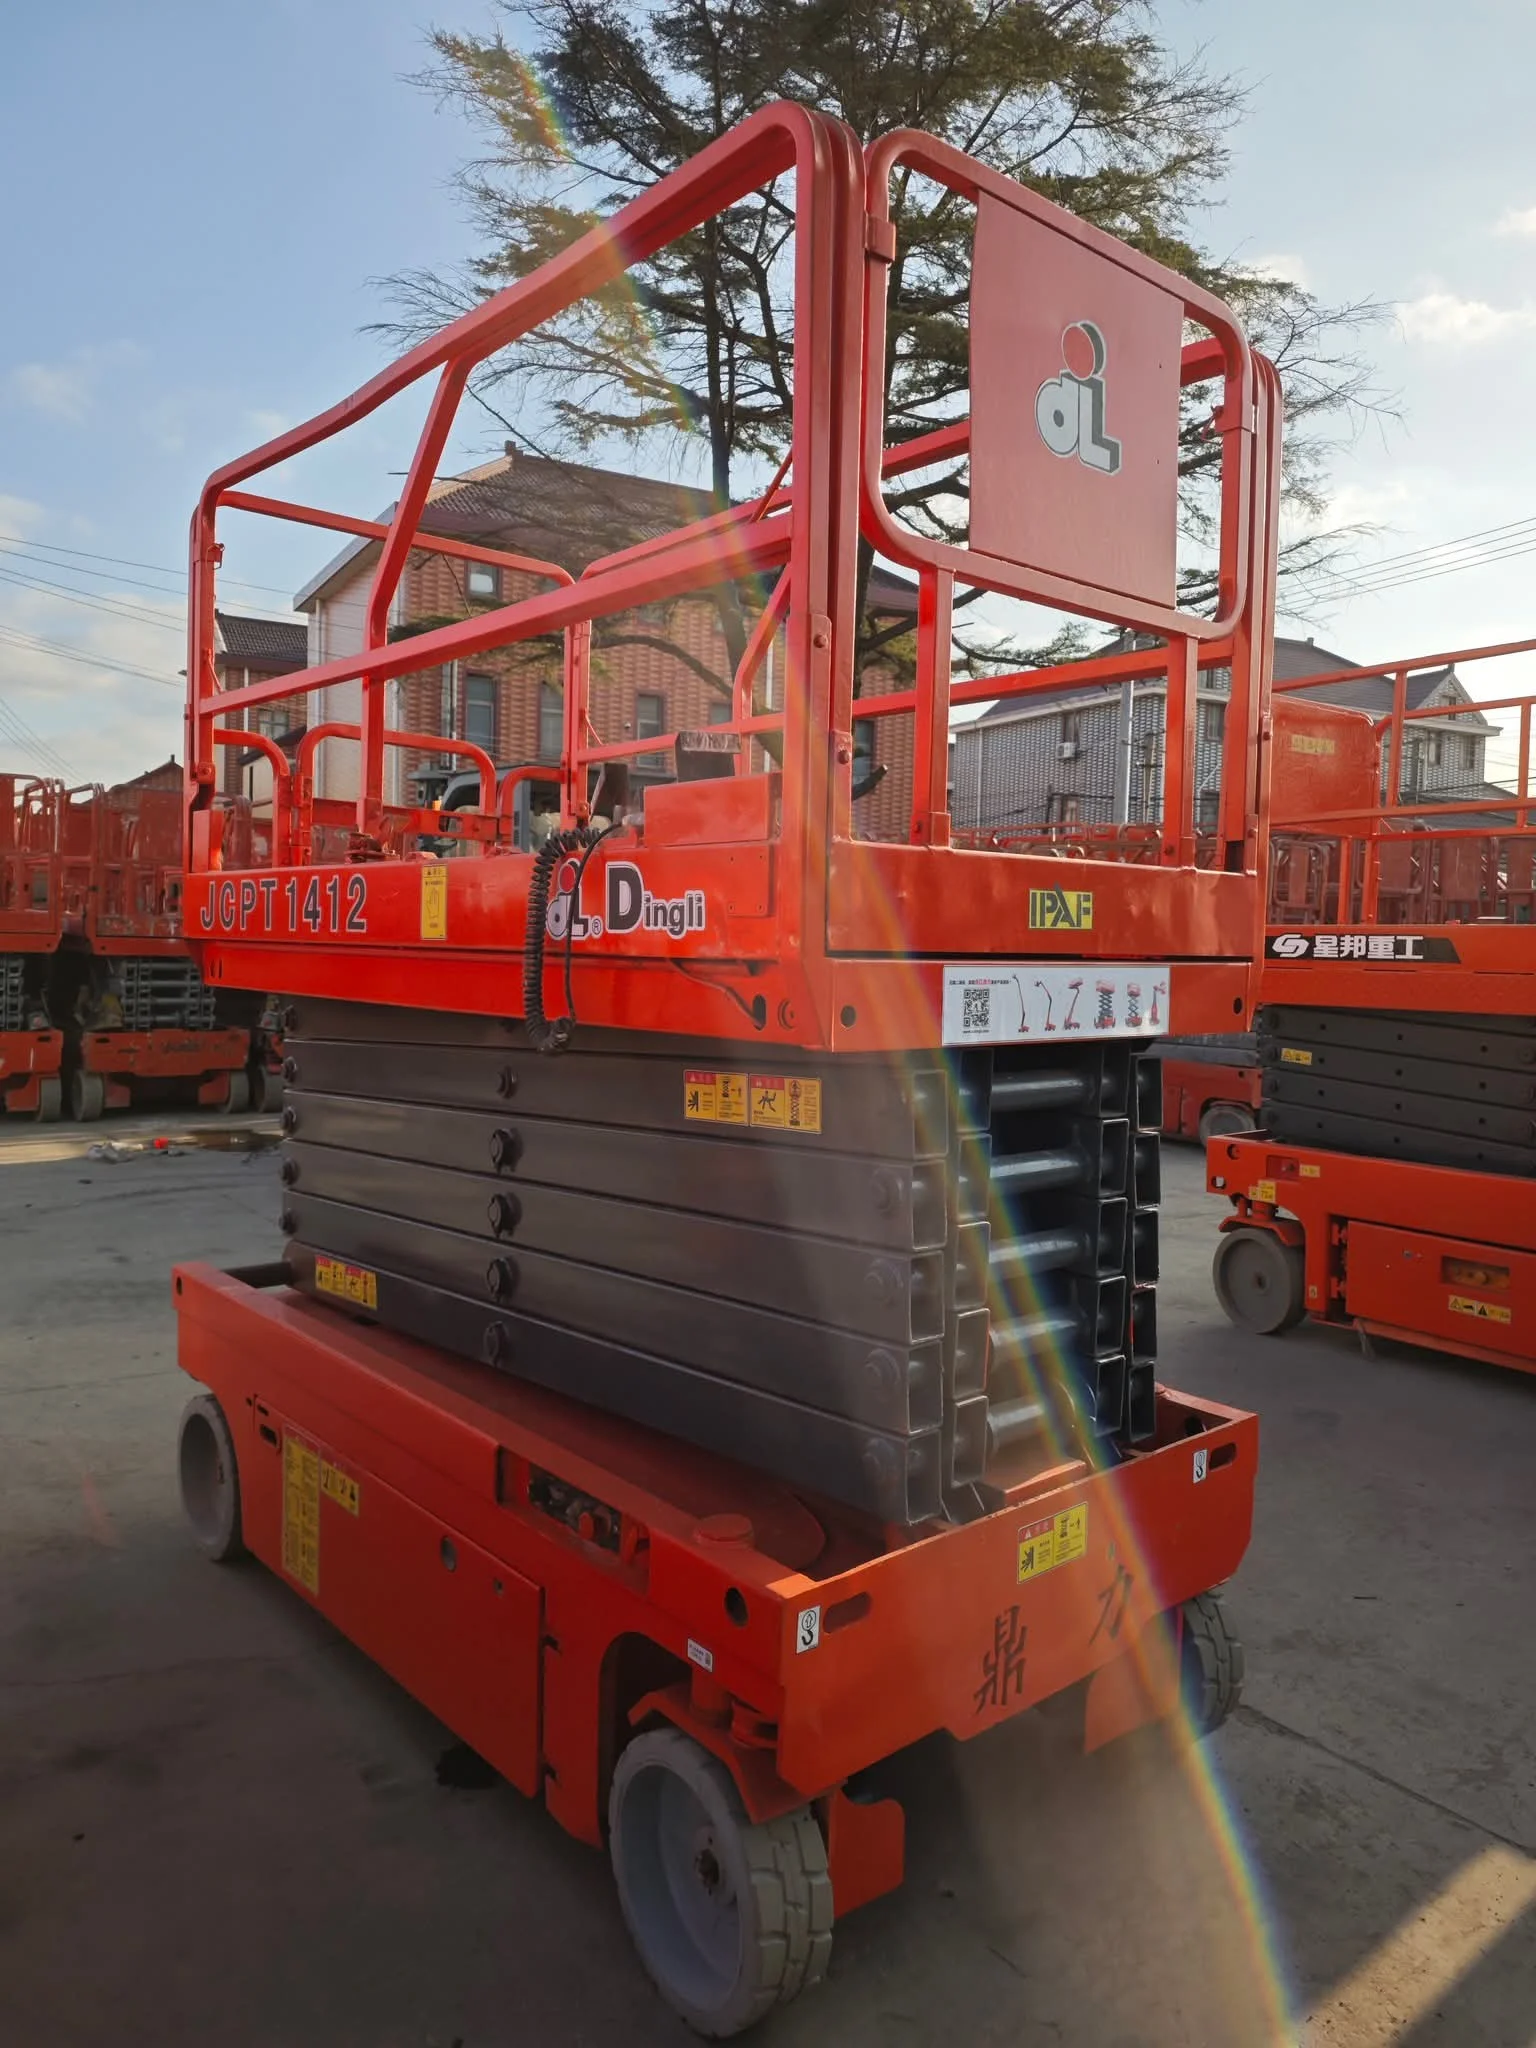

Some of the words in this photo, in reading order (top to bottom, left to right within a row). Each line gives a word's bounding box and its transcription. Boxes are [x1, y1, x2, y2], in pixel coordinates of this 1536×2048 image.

[607, 862, 705, 937] Dingli
[1030, 882, 1091, 928] IPAF
[1312, 935, 1424, 960] 星邦重工
